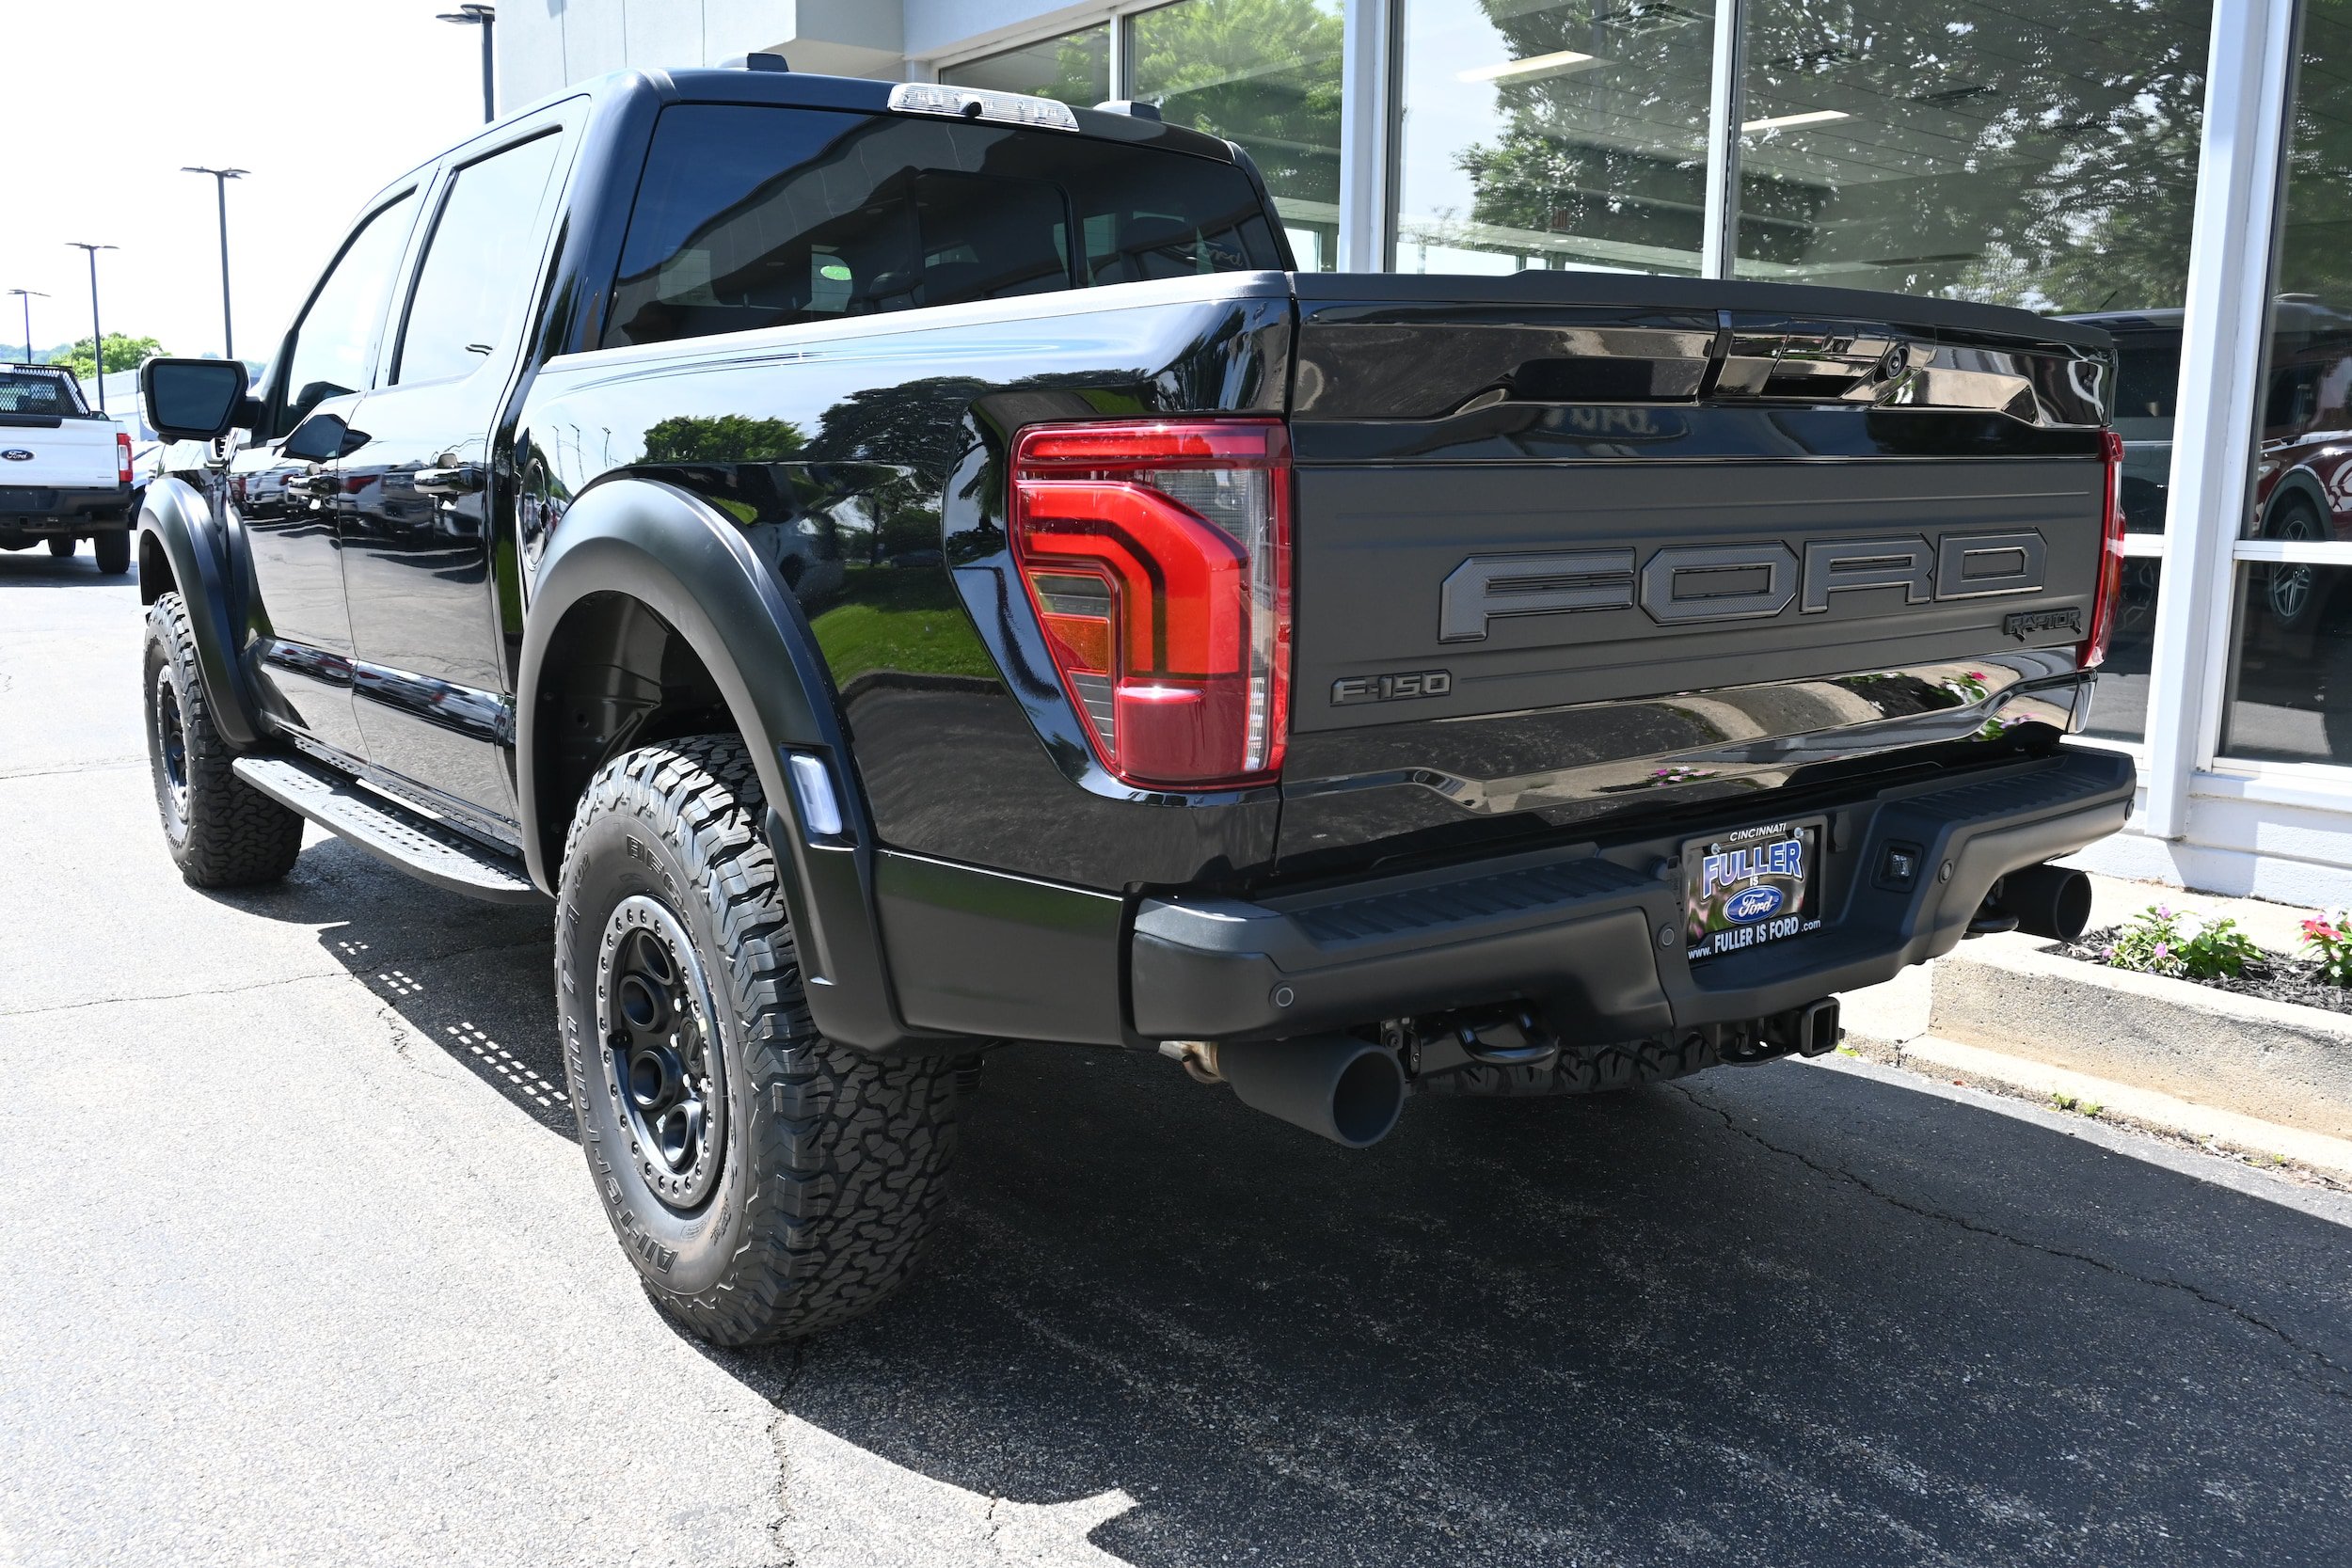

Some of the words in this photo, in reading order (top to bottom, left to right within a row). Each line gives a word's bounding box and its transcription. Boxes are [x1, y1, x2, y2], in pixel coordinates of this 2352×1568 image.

[7, 451, 28, 460] Ford
[1438, 526, 2048, 643] FORD
[2004, 607, 2082, 642] RAPTOR
[1330, 670, 1452, 705] F-150
[1729, 822, 1788, 842] CINCINNATI
[1702, 839, 1804, 901] FULLER
[1749, 876, 1759, 886] IS
[1739, 892, 1774, 917] Ford
[1687, 946, 1712, 959] www.
[1714, 927, 1754, 954] FULLER
[1756, 926, 1767, 943] IS
[1769, 917, 1799, 941] FORD
